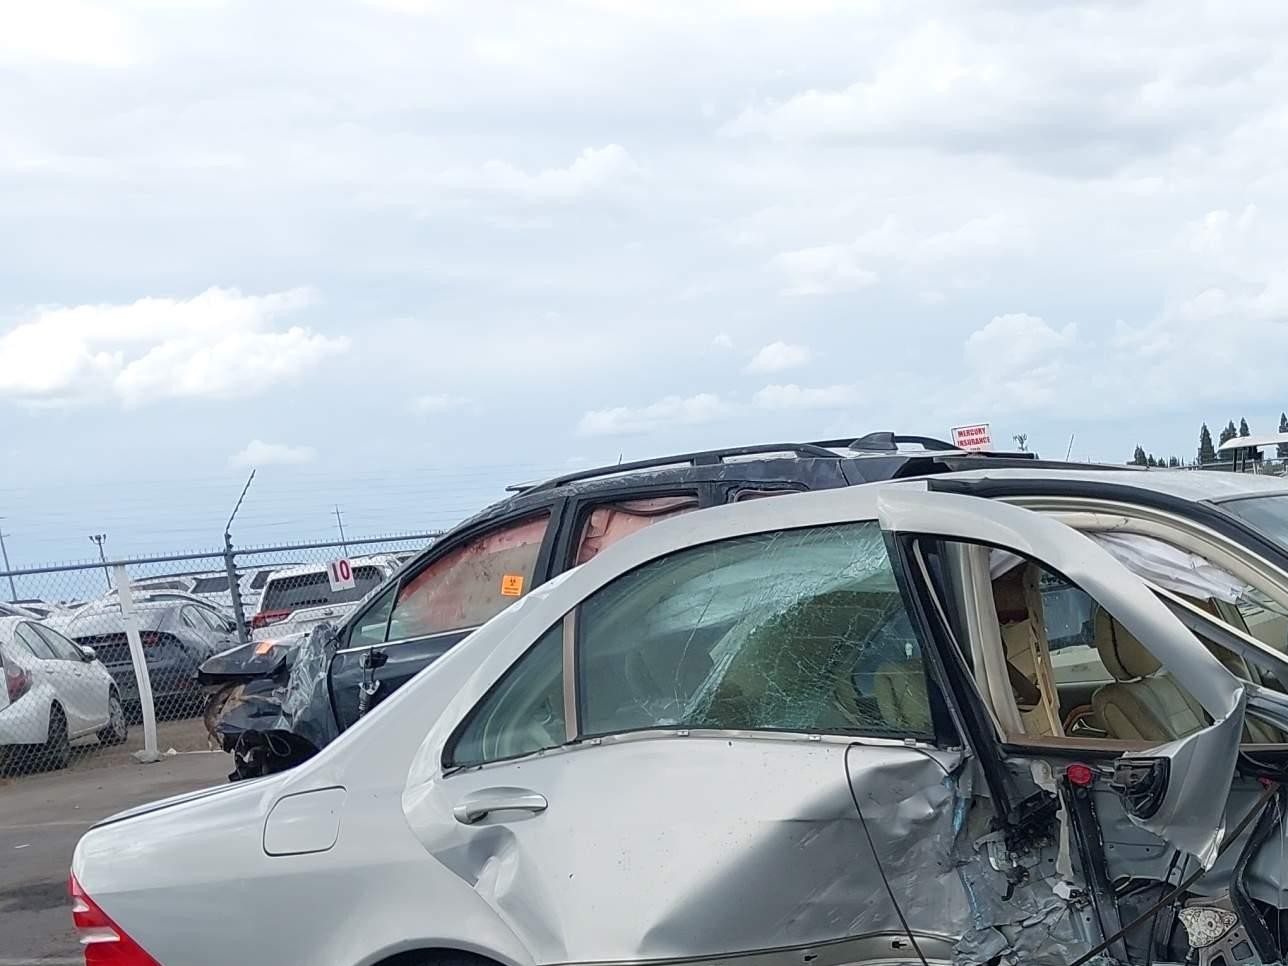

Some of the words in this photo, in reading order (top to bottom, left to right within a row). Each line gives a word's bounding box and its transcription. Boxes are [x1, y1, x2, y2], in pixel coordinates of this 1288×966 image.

[957, 427, 986, 438] MERCURY
[957, 437, 991, 447] INSURANCE
[332, 559, 350, 583] 10
